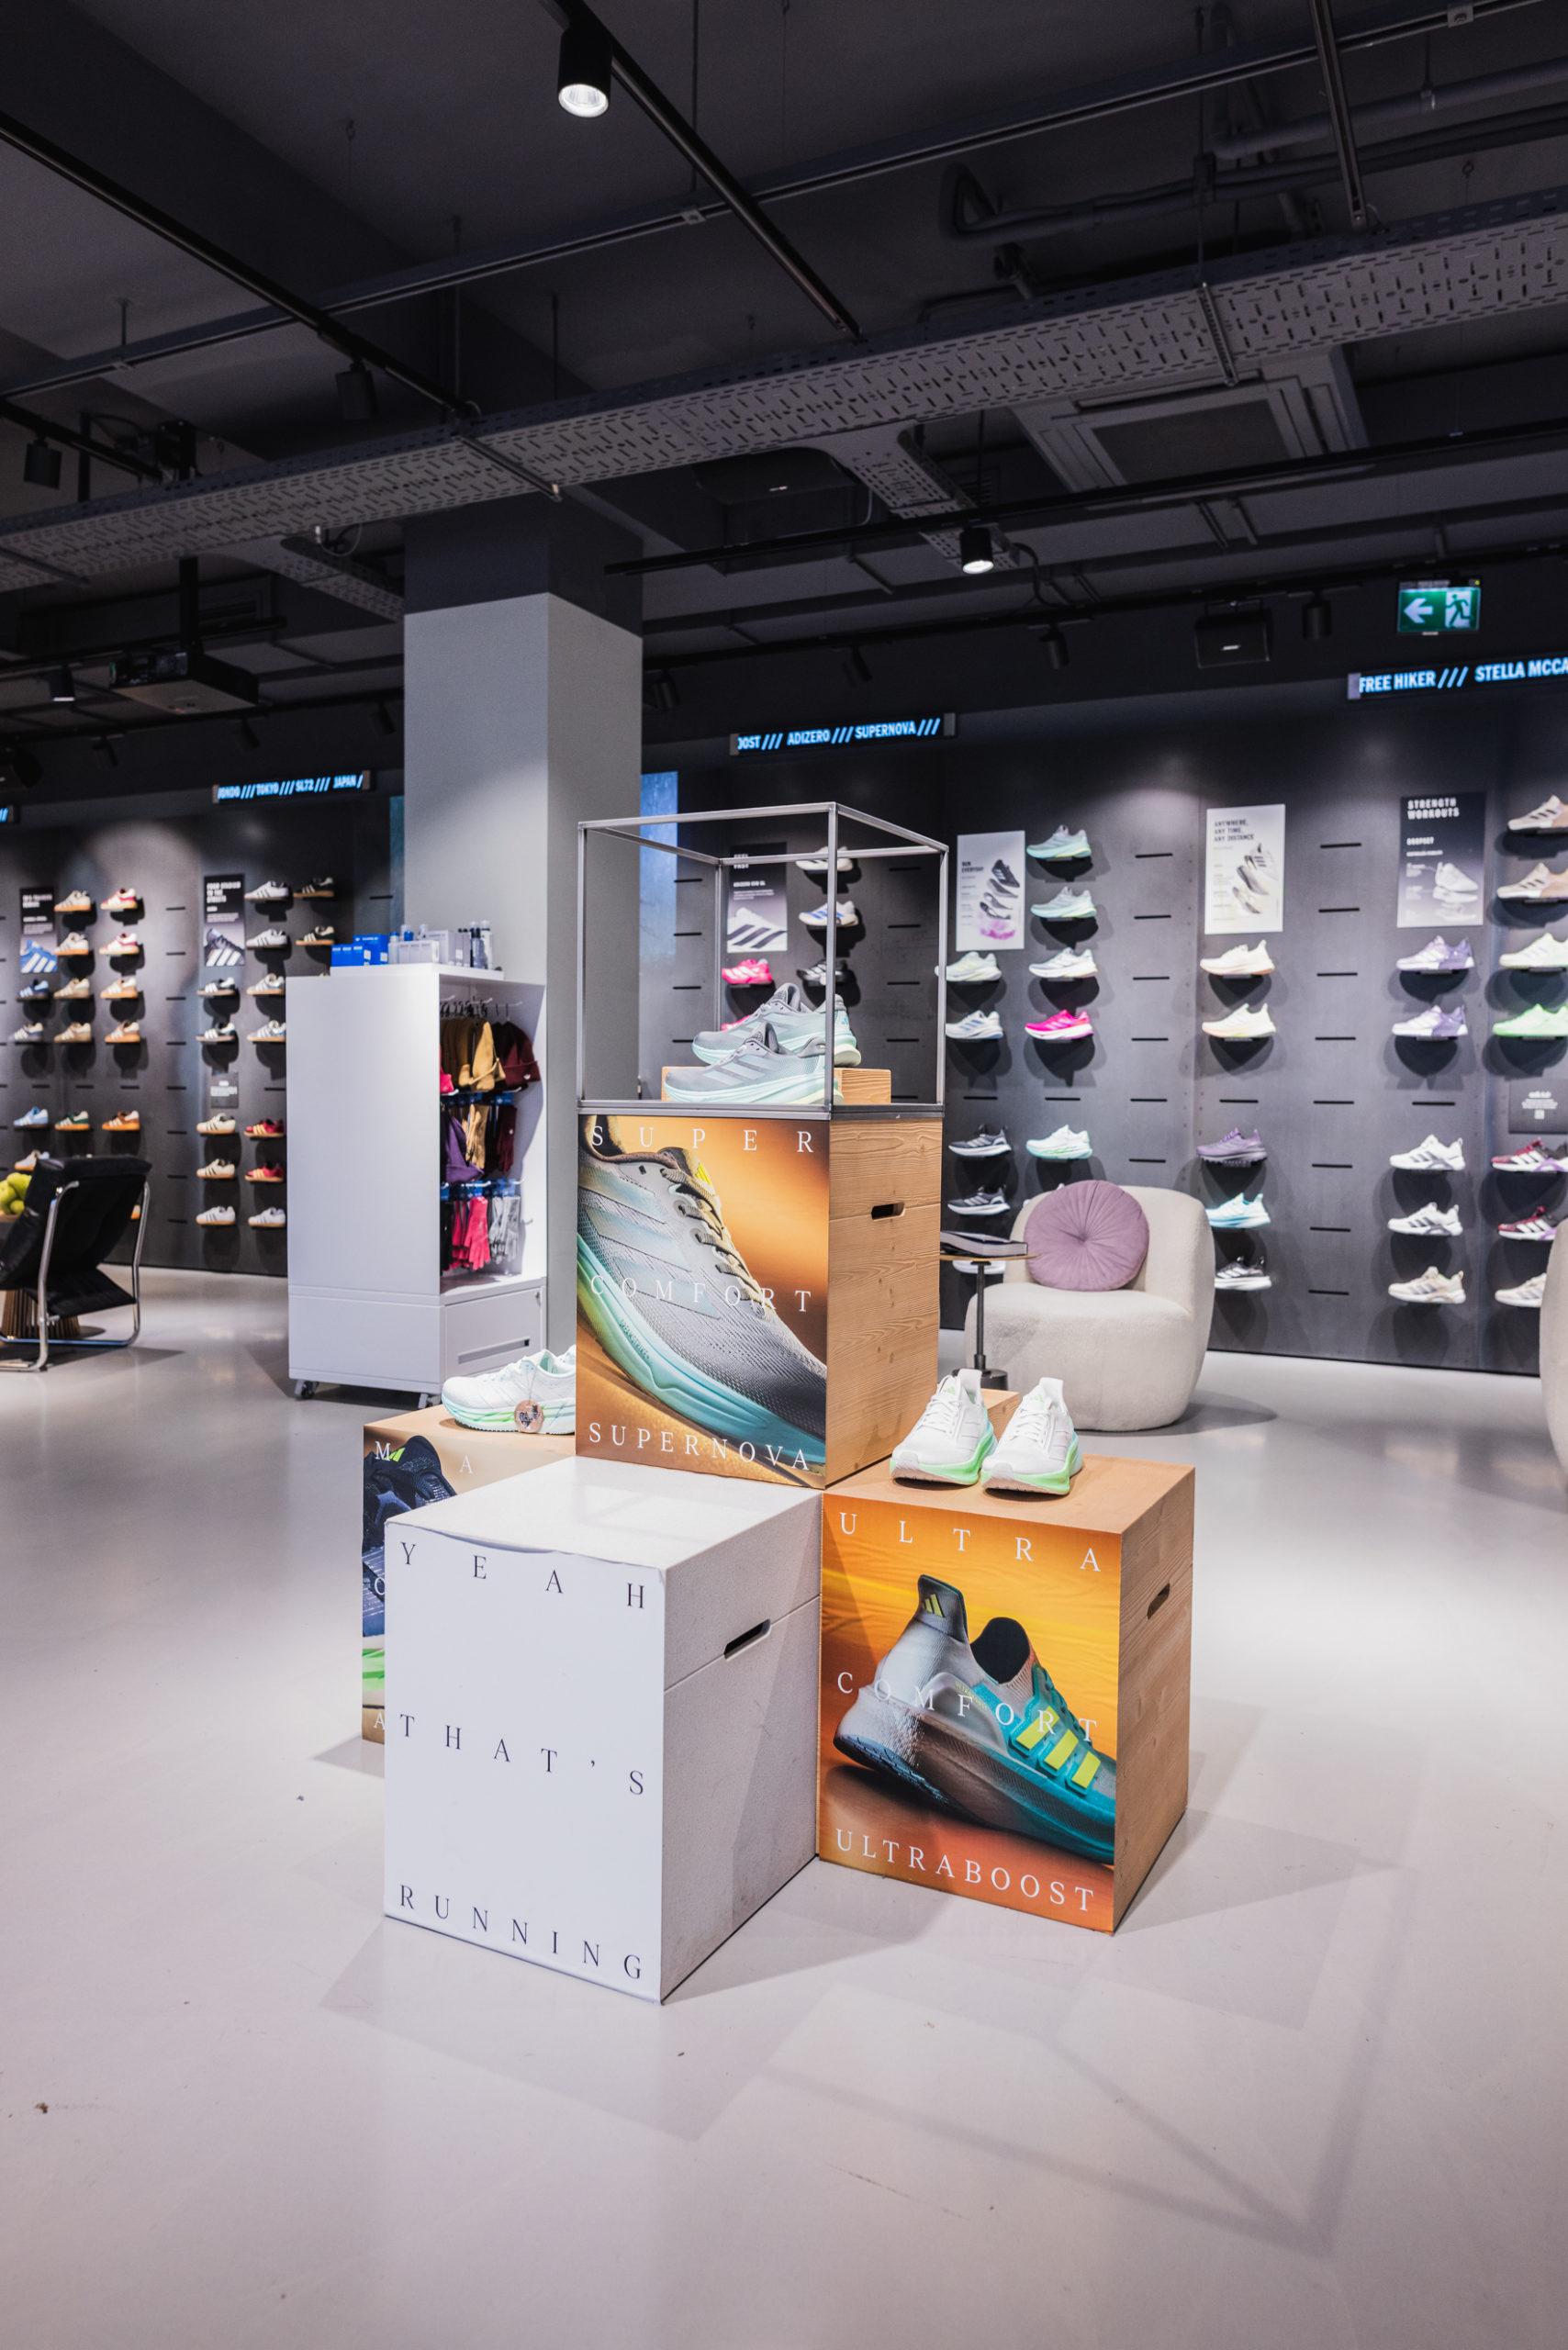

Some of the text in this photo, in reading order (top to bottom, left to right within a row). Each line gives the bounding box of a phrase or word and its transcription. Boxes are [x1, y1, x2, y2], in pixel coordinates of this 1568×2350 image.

[1359, 675, 1392, 693] FREE
[1394, 670, 1437, 689] HIKER
[1474, 661, 1526, 682] STELLA
[787, 730, 830, 745] ADIZERO
[855, 721, 917, 739] SUPERNOVA
[295, 778, 314, 792] SL72
[333, 775, 357, 789] JAPAN
[1407, 798, 1456, 810] STRENGTH
[1407, 807, 1460, 820] WORKOUTS
[591, 1125, 814, 1153] SUPER
[590, 1275, 812, 1313] COMFORT
[588, 1423, 810, 1471] SUPERNOVA
[839, 1512, 1101, 1572] ULTRA
[400, 1542, 644, 1608] YEAH
[837, 1672, 1098, 1742] COMFORT
[836, 1828, 1093, 1911] ULTRABOOST
[400, 1885, 642, 1979] RUNNING
